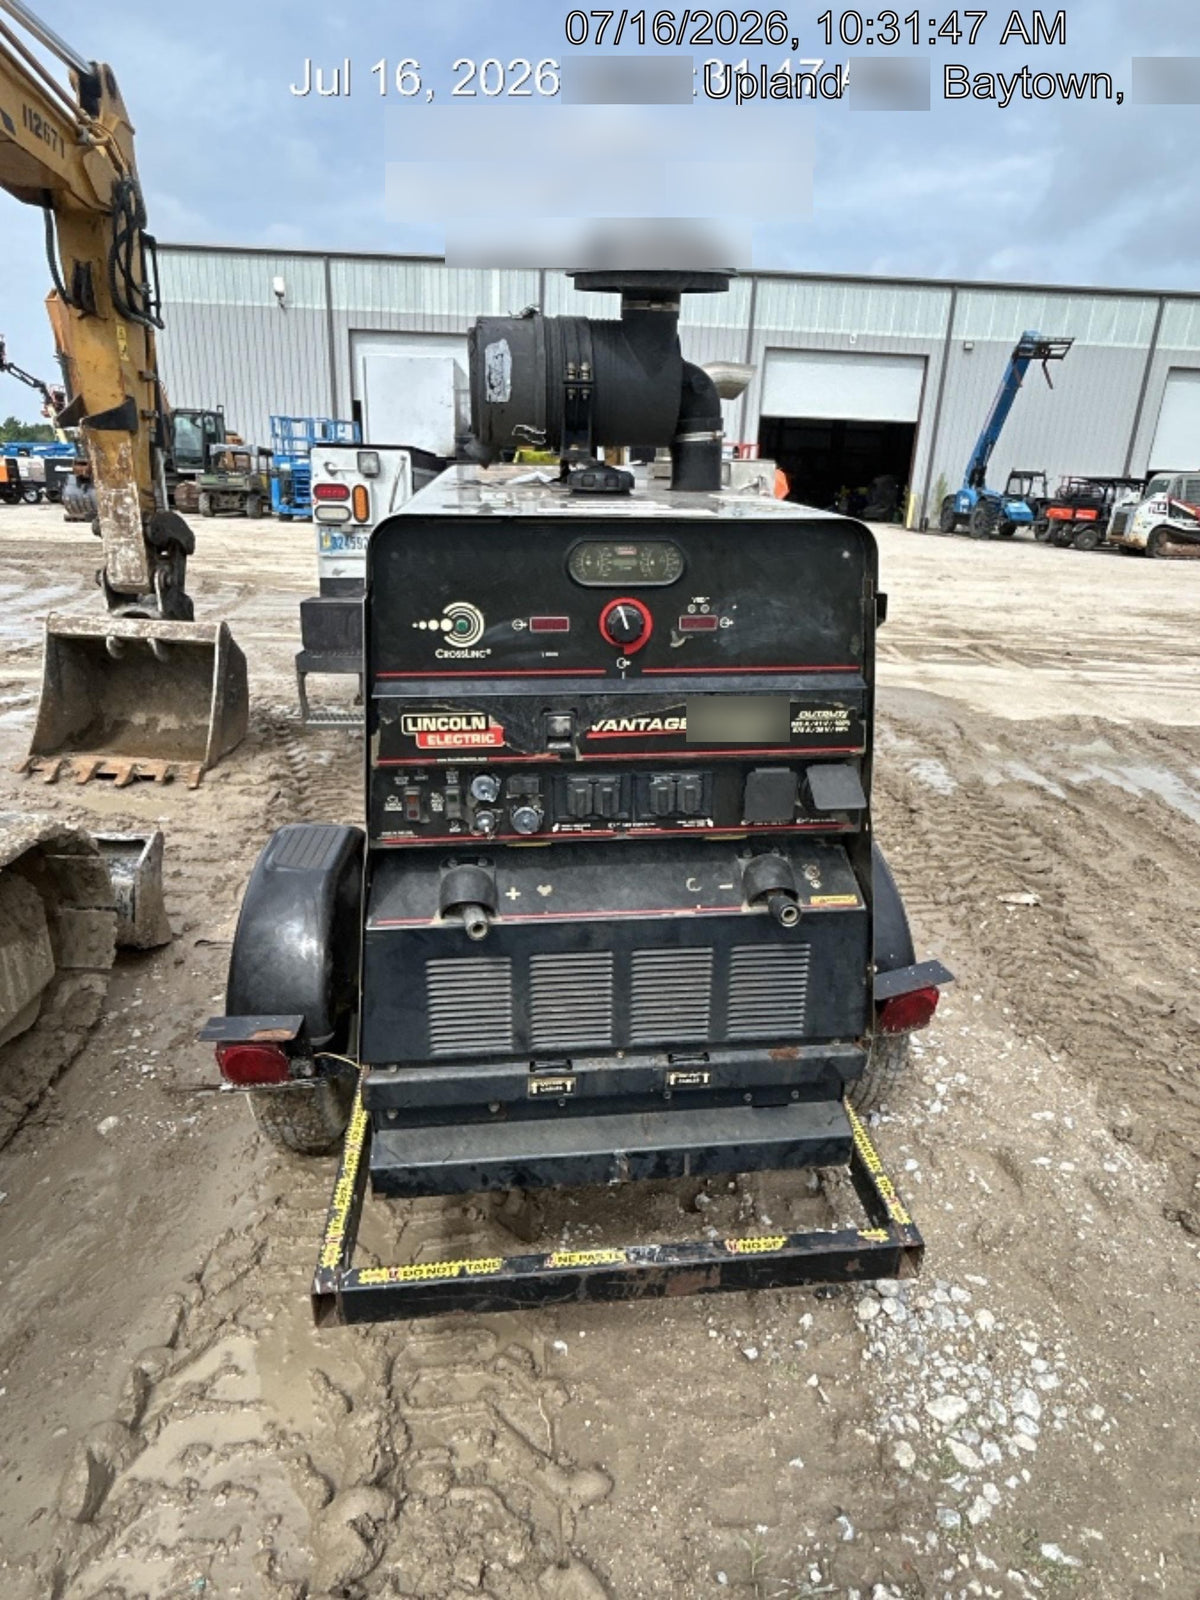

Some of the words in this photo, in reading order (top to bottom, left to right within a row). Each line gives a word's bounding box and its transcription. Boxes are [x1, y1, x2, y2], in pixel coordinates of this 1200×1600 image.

[406, 715, 486, 732] LINCOLN
[426, 733, 496, 746] ELECTRIC
[742, 1242, 761, 1250] NO
[557, 1255, 576, 1263] NE
[403, 1269, 424, 1277] DO
[426, 1265, 454, 1275] NOT
